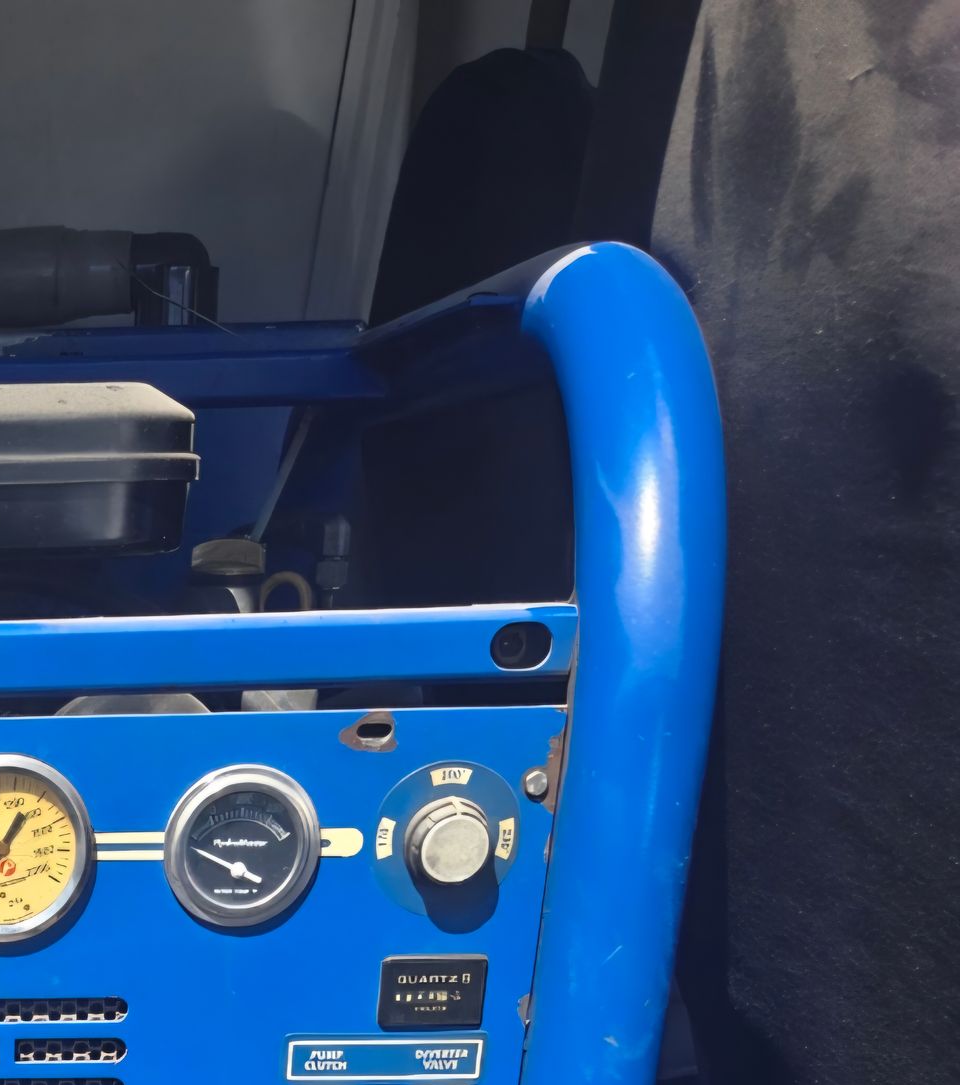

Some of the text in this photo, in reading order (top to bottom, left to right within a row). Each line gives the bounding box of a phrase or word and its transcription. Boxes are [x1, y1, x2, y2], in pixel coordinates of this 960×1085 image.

[398, 975, 458, 984] QUARTZ
[304, 1061, 348, 1071] CLUTCH
[423, 1060, 458, 1070] VALVE
